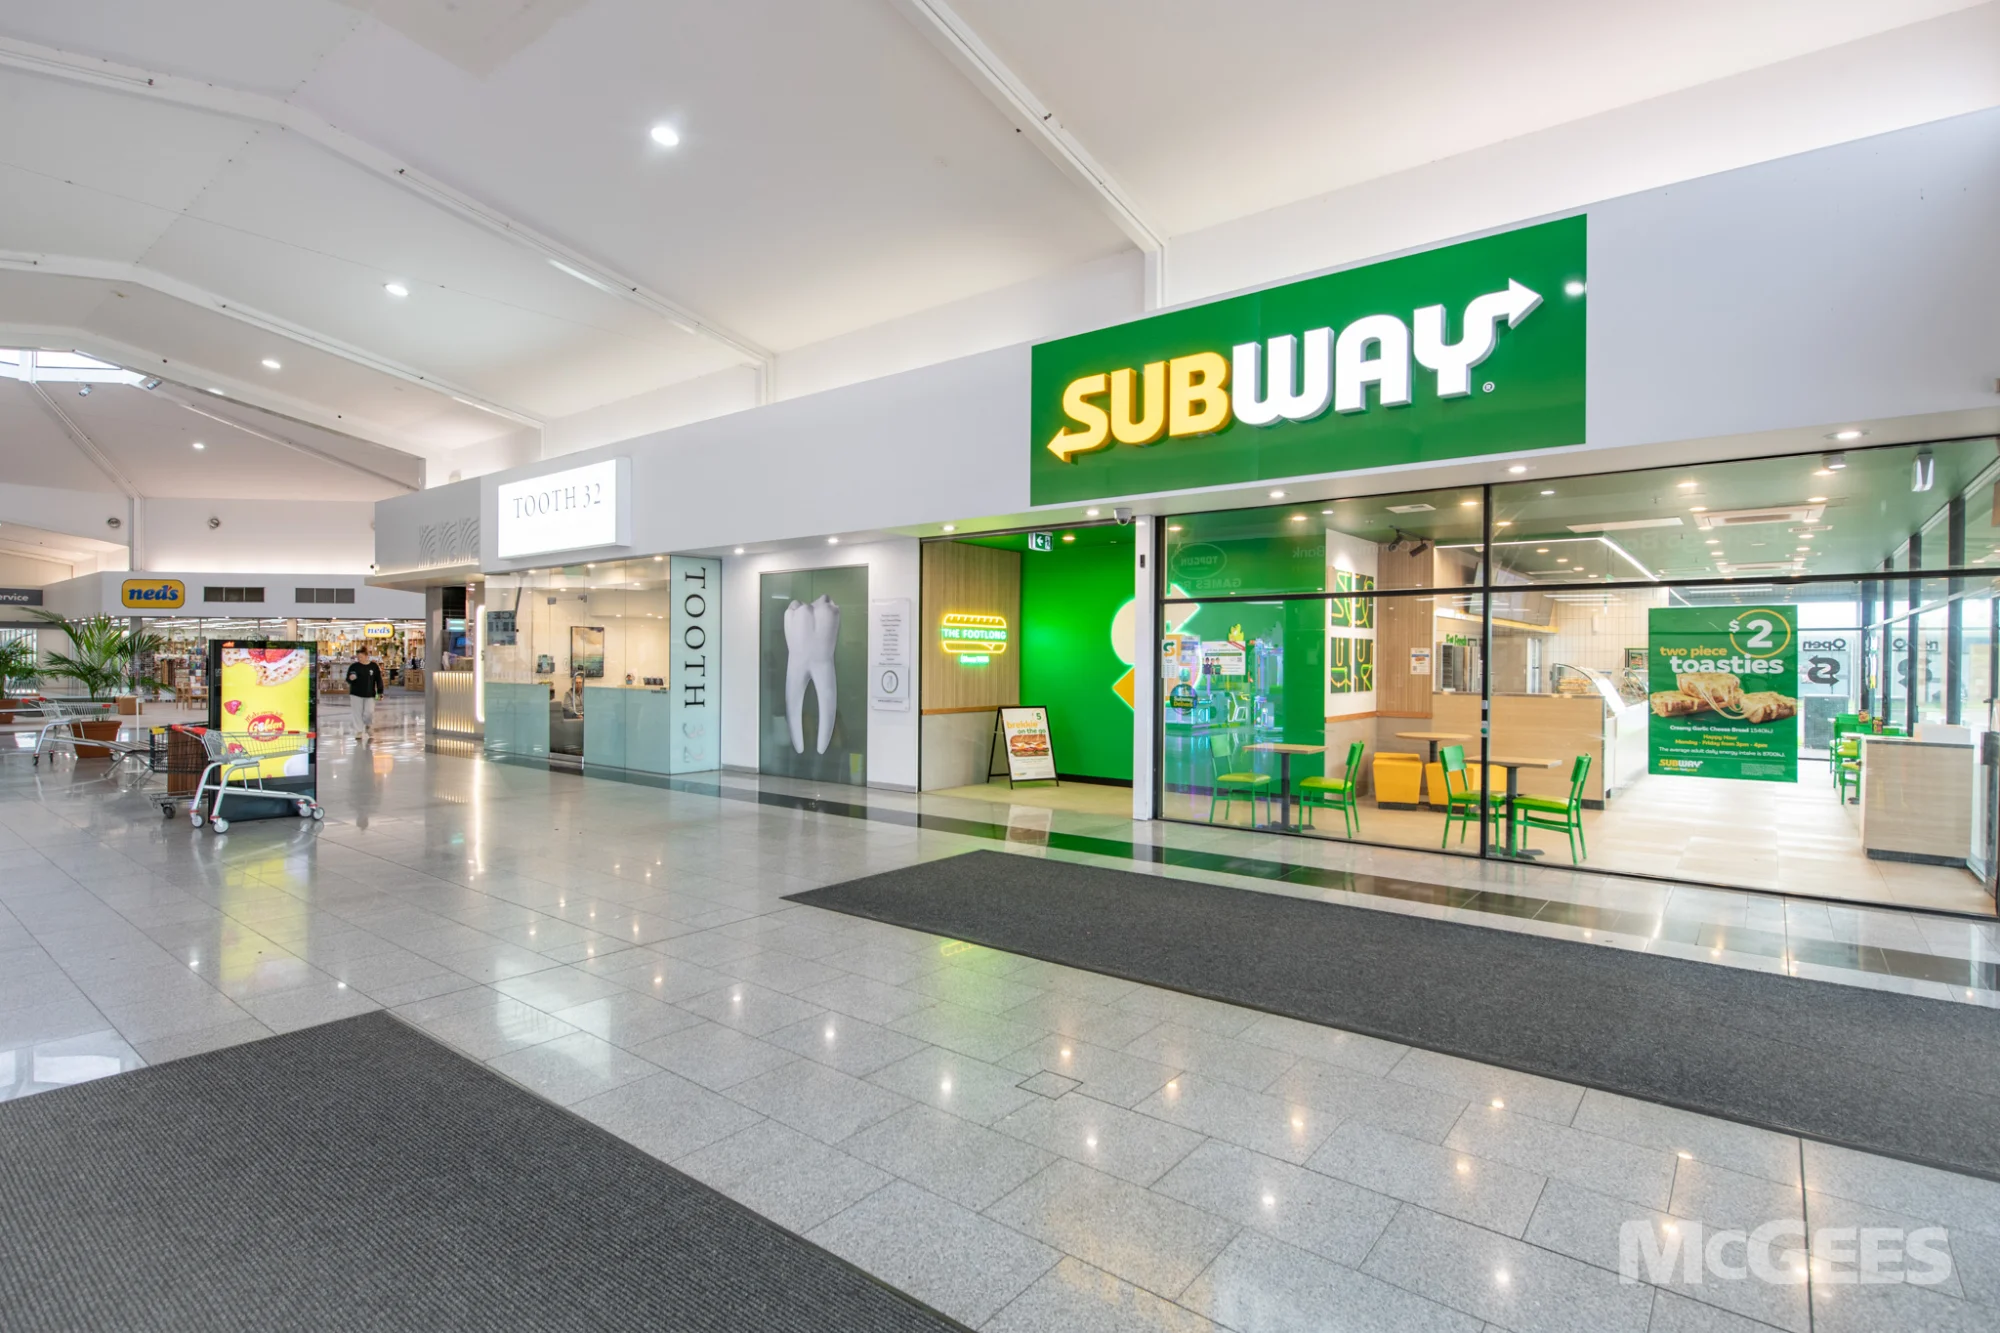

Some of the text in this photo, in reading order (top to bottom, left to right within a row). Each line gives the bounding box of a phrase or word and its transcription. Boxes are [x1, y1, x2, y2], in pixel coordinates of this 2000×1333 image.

[1047, 277, 1544, 464] SUBWAY
[513, 483, 601, 518] TOOTH 32
[128, 585, 178, 601] ned's
[684, 566, 706, 708] TOOTH
[942, 628, 1007, 640] THE FOOTLONG
[1660, 645, 1728, 658] two piece
[1669, 653, 1784, 674] toasties
[1658, 759, 1704, 768] SUBWAY
